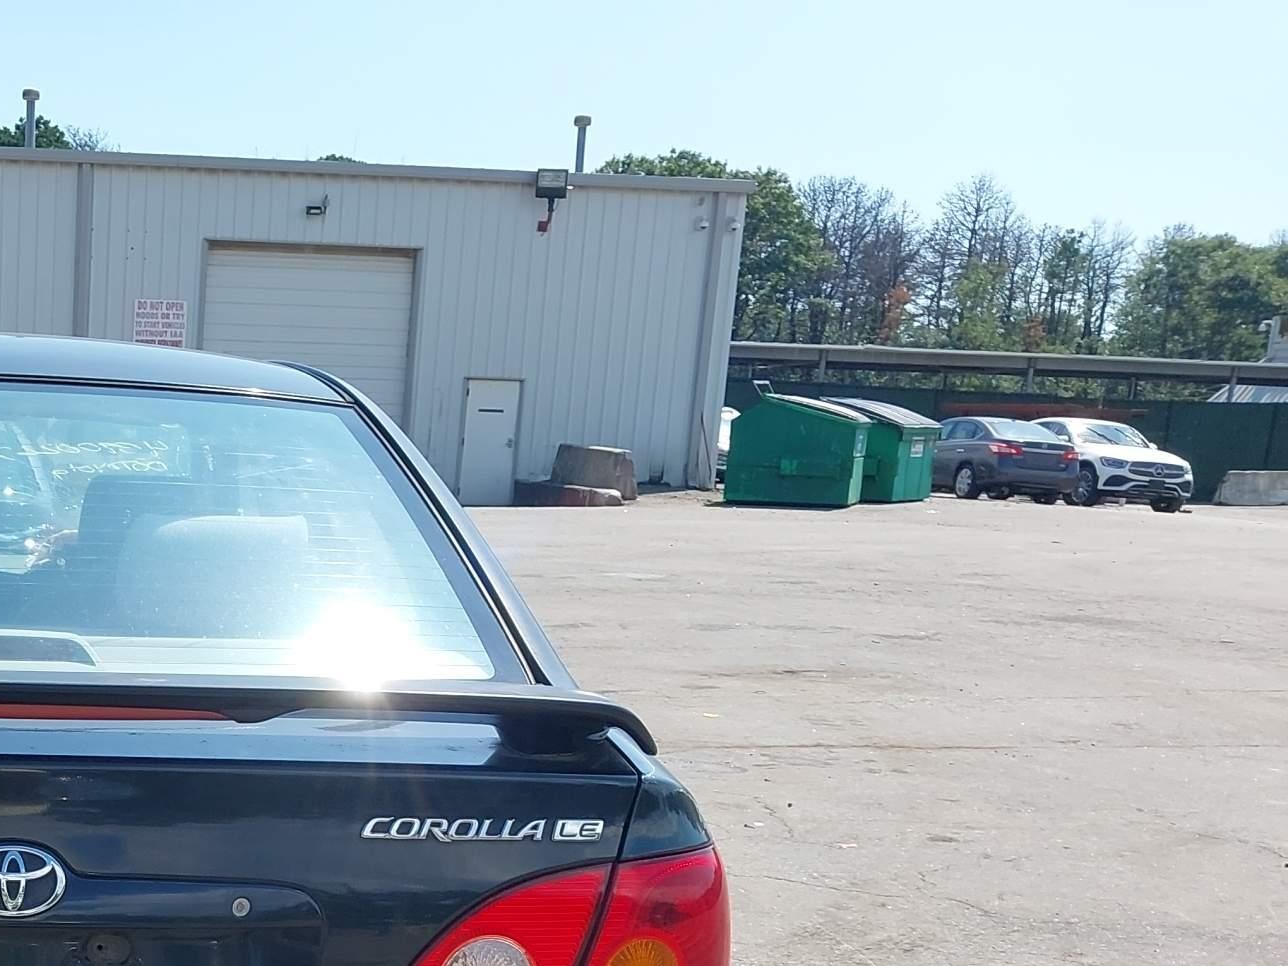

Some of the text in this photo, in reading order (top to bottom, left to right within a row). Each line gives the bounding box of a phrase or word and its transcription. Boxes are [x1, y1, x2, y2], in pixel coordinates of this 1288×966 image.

[137, 300, 184, 312] DO NOT OPEN
[161, 312, 171, 320] OR
[135, 329, 168, 338] WITHOUT
[361, 816, 604, 843] COROLLA LE
